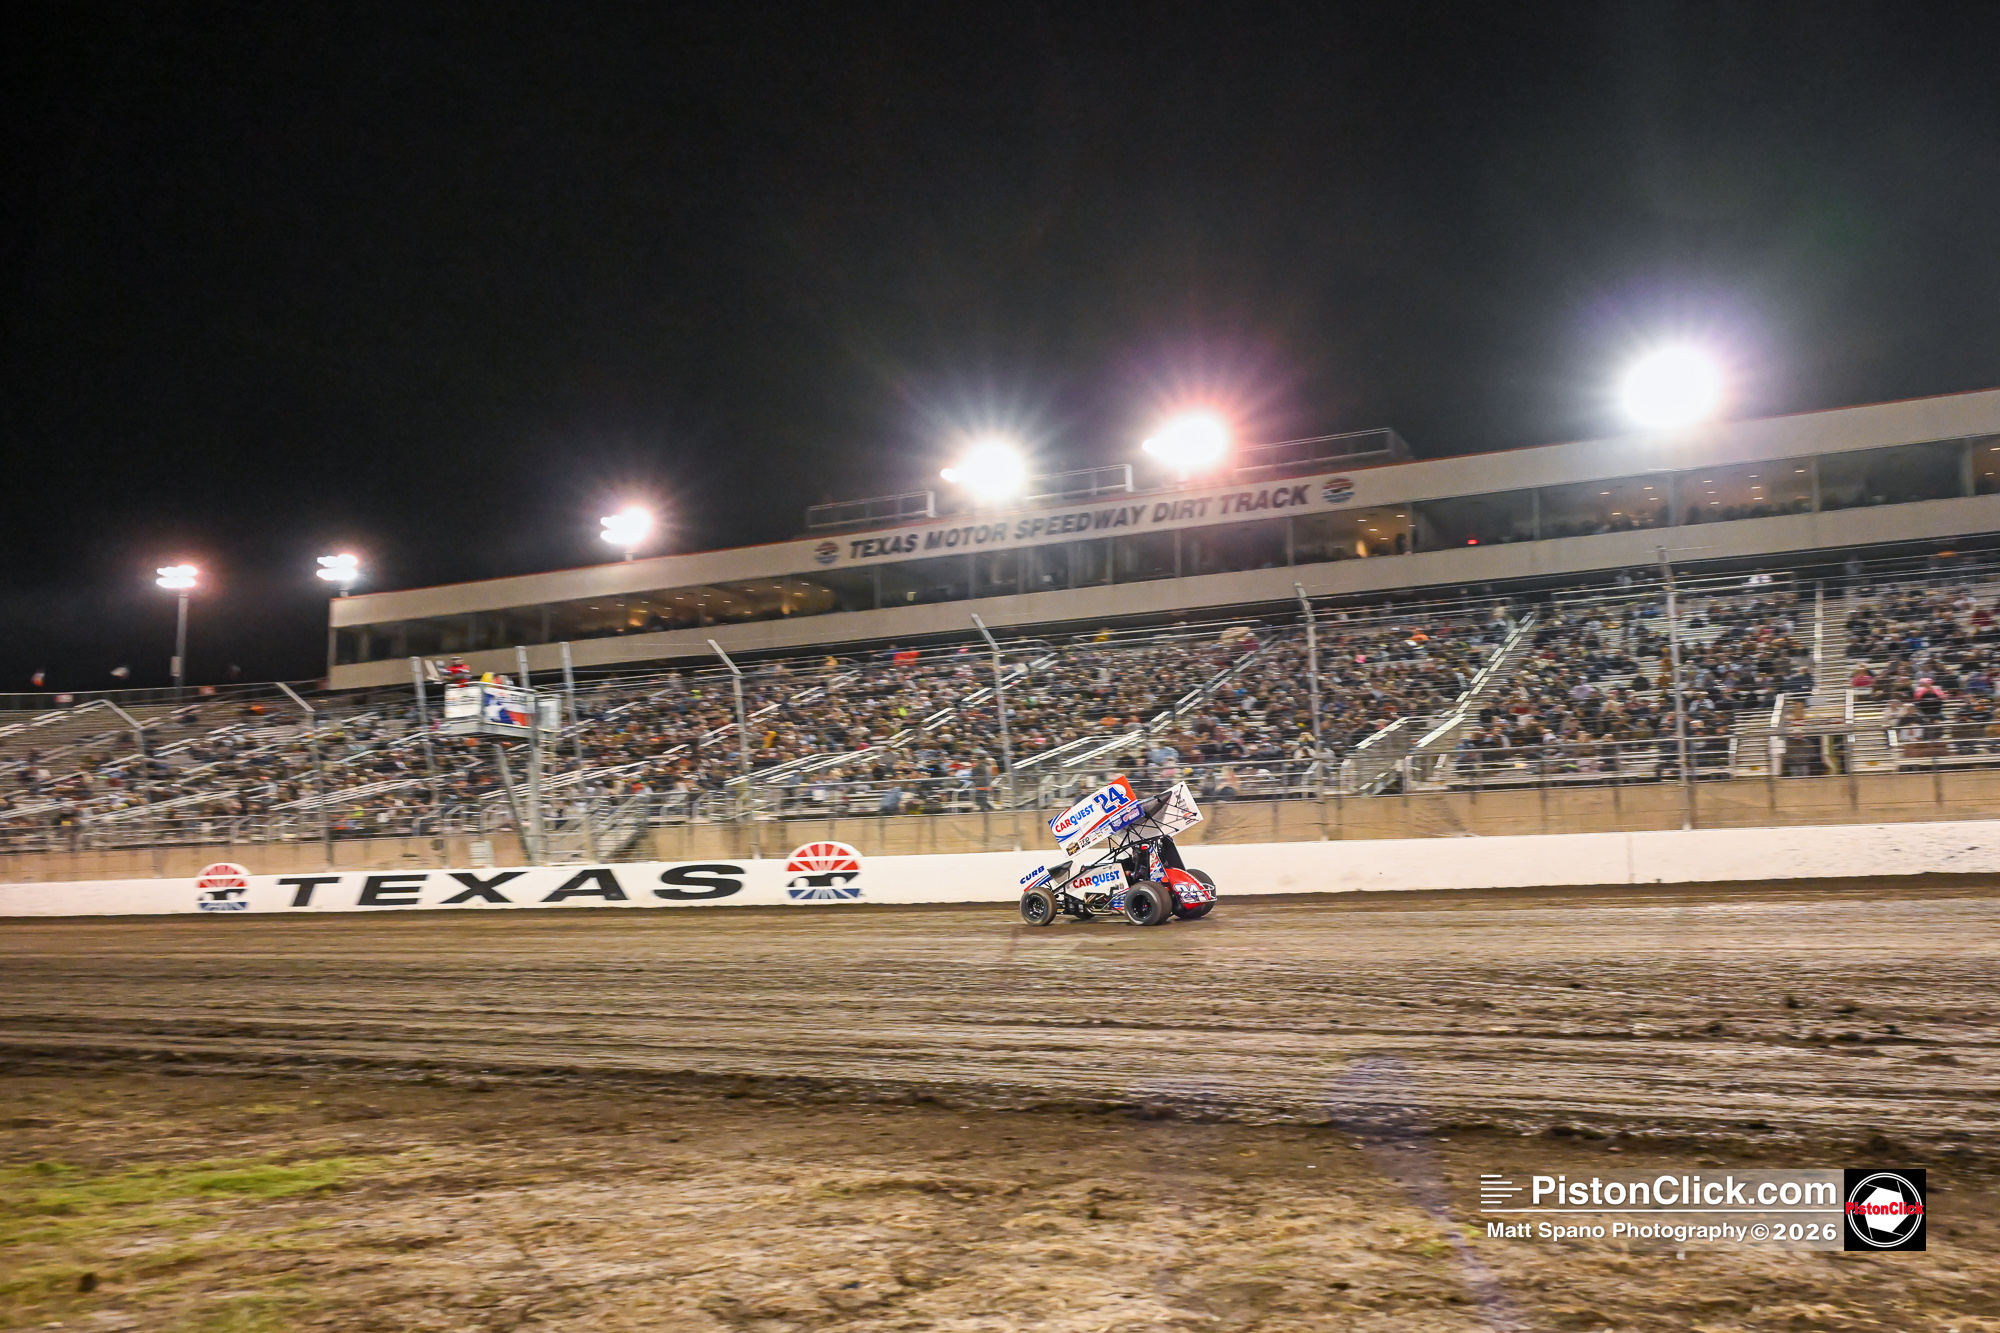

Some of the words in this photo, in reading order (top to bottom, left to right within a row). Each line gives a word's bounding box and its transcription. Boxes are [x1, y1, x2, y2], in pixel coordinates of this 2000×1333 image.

[849, 533, 919, 559] TEXAS
[923, 522, 1009, 550] MOTOR
[1013, 504, 1148, 541] SPEEDWAY
[1152, 496, 1213, 526] DIRT
[1218, 483, 1312, 520] TRACK
[1094, 786, 1131, 814] 24
[1055, 803, 1095, 833] CARQUEST
[277, 863, 746, 907] TEXAS
[1020, 865, 1045, 885] CURB
[1072, 869, 1120, 889] CARQUEST
[1173, 884, 1209, 904] 24
